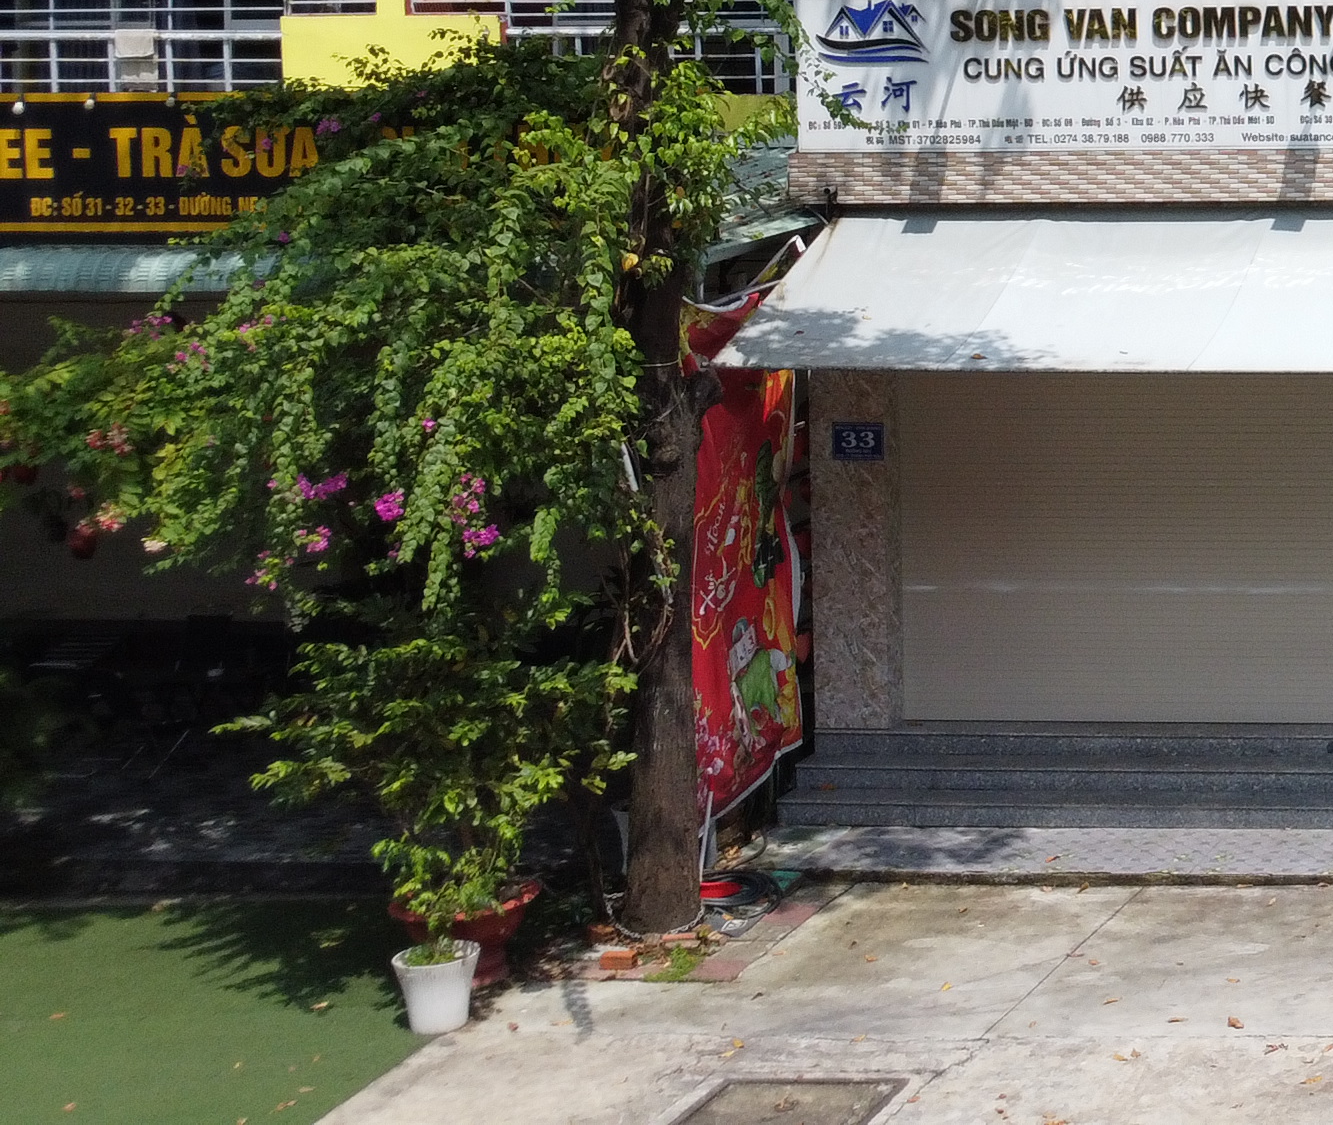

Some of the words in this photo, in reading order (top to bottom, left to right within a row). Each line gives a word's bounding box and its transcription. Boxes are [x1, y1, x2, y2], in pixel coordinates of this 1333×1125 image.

[950, 8, 1050, 43] SONG
[1063, 7, 1137, 41] VAN
[963, 56, 1045, 80] CUNG
[1056, 50, 1119, 79] ỨNG
[1129, 46, 1203, 78] SUẤT
[1212, 48, 1252, 77] ĂN
[109, 115, 210, 178] TRÀ
[61, 191, 83, 217] SỐ
[85, 197, 102, 216] 31
[115, 196, 134, 216] 32
[146, 196, 165, 216] 33
[840, 430, 876, 448] 33
